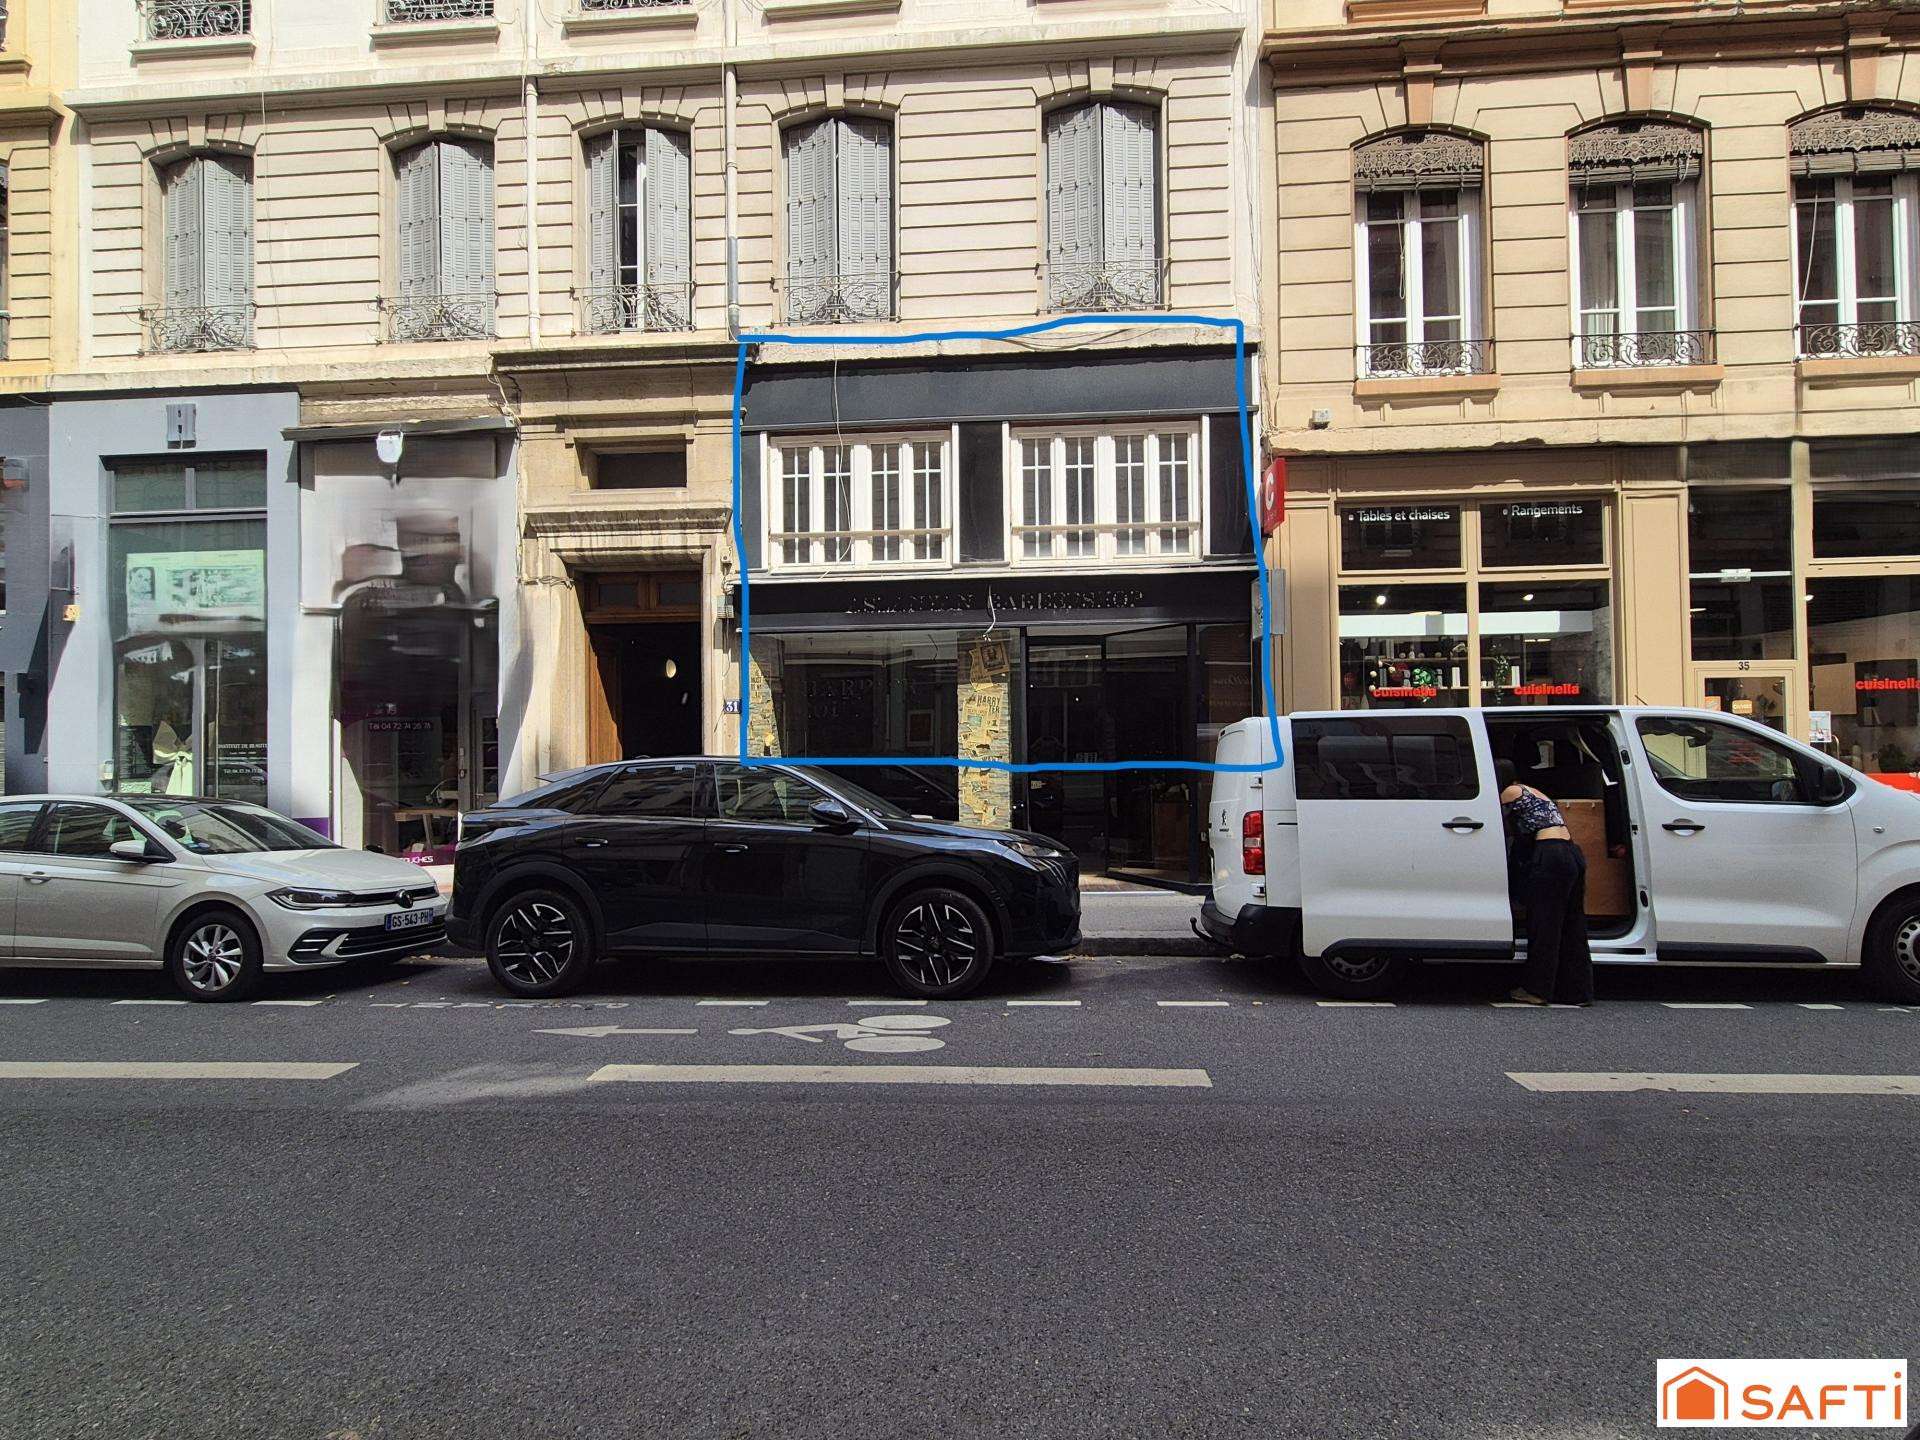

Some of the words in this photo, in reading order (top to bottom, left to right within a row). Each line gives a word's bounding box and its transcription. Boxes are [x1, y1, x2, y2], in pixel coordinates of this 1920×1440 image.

[1357, 510, 1392, 522] Tables
[1394, 509, 1406, 521] et
[1408, 508, 1450, 521] chaises
[1511, 504, 1583, 517] Rangements
[1738, 661, 1750, 670] 35
[1514, 683, 1580, 695] cuisinella
[726, 701, 739, 713] 31
